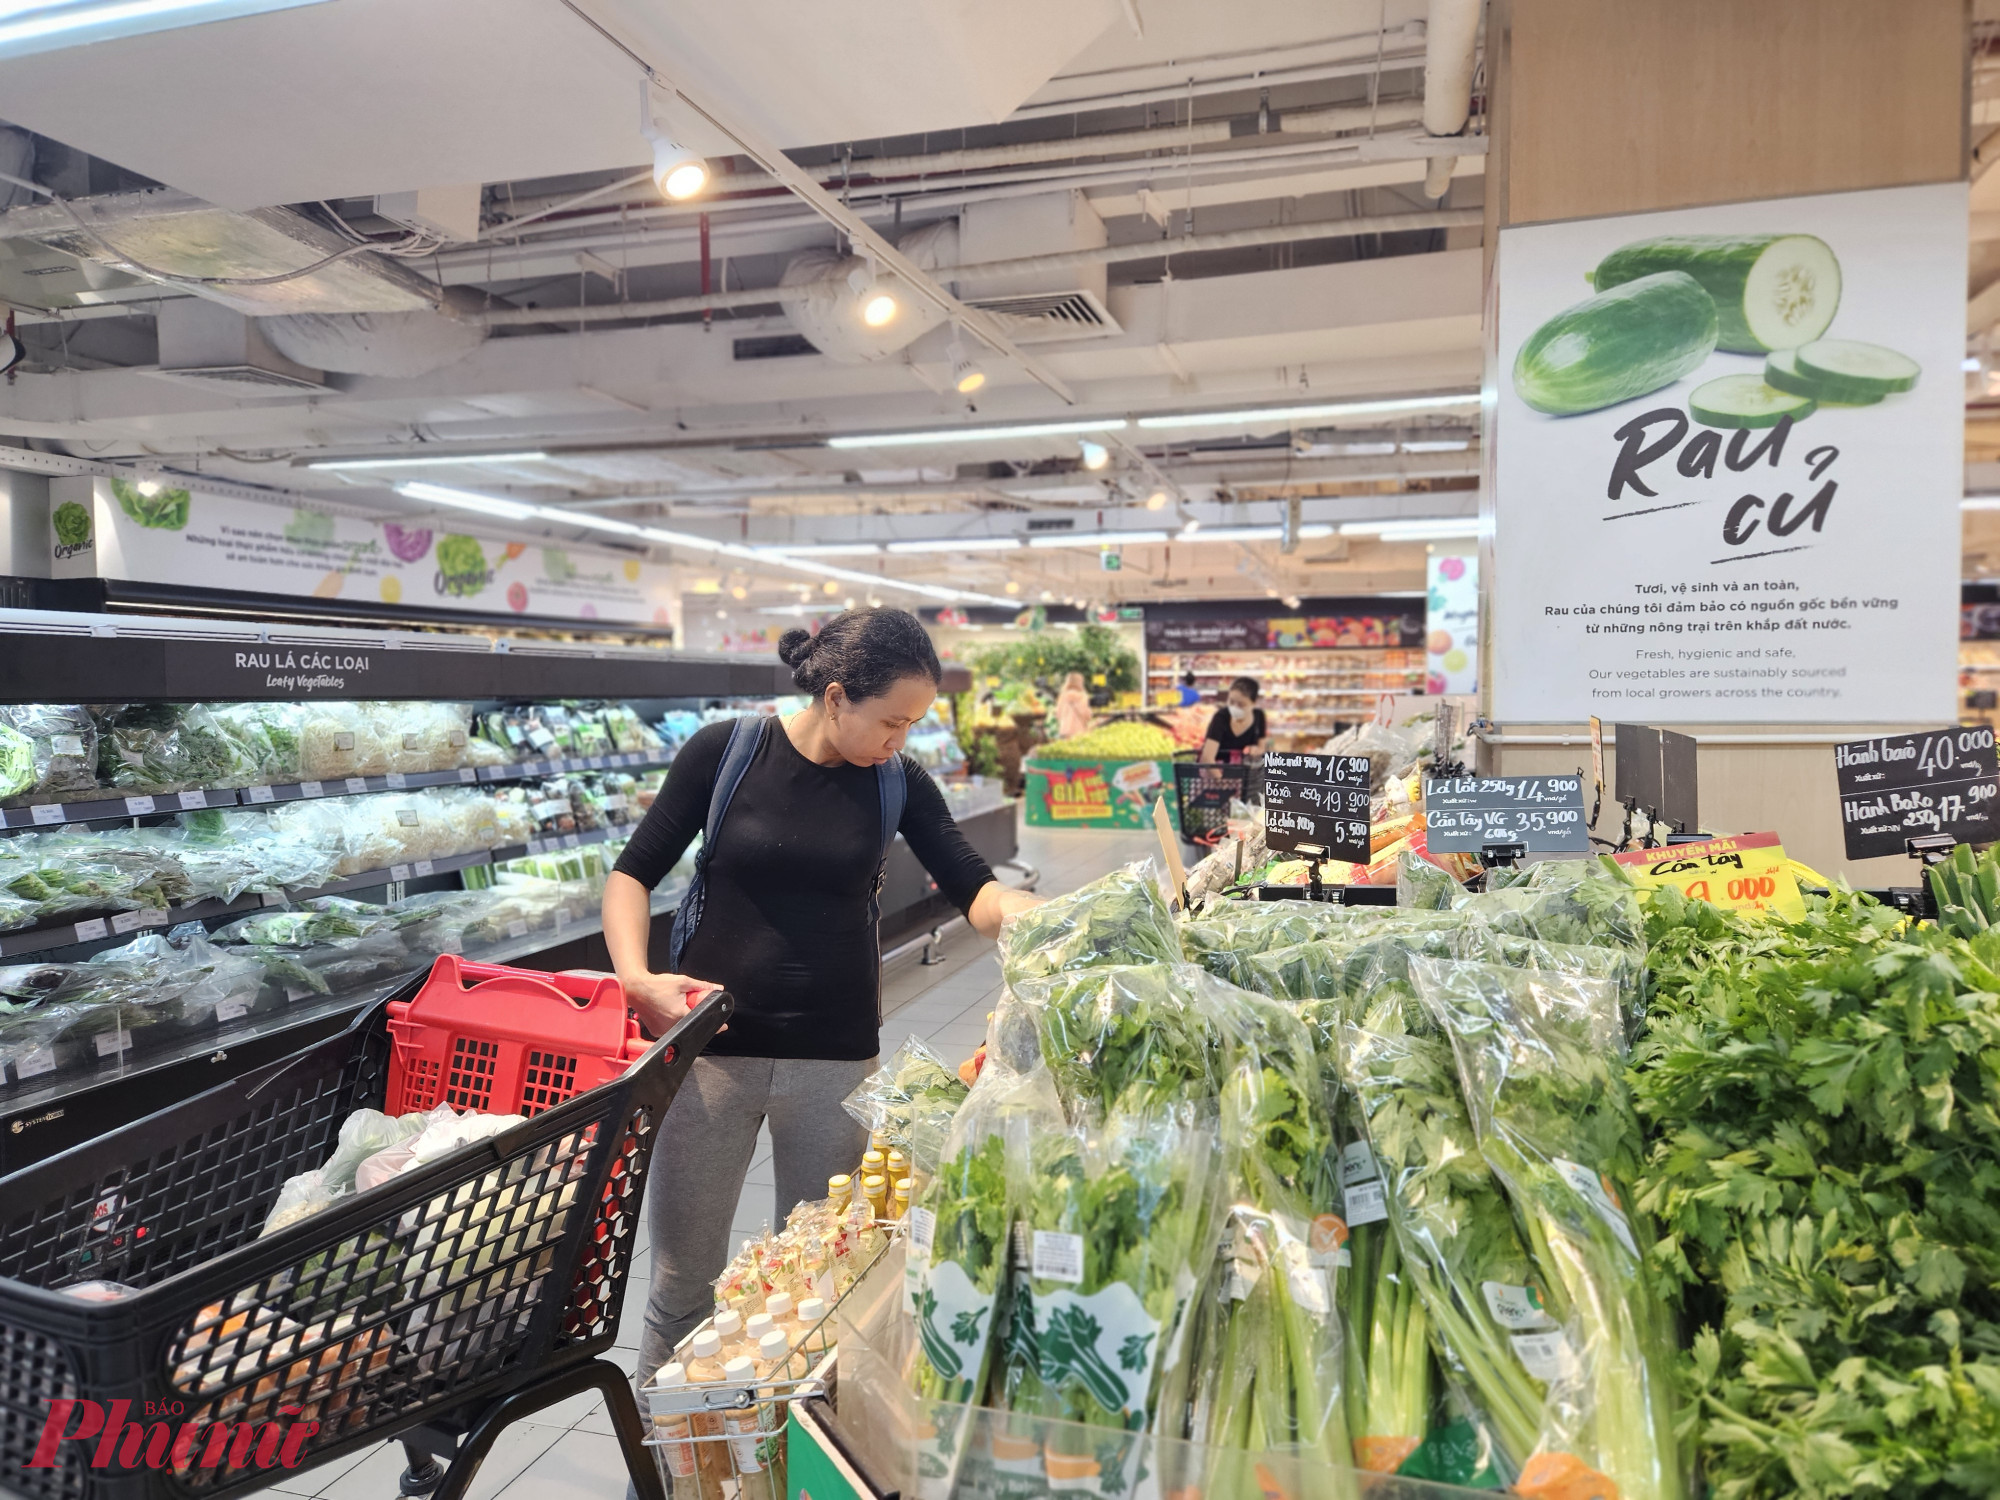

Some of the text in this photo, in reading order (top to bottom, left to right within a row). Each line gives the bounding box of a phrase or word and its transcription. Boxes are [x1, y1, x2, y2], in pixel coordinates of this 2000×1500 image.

[1607, 408, 1794, 500] Rau
[1722, 445, 1840, 546] củ
[55, 539, 93, 559] Organic
[1635, 580, 1799, 595] Tươi, vệ sinh và an toàn,
[1545, 607, 1569, 616] Rau
[1573, 604, 1596, 615] của
[1600, 603, 1640, 616] chúng
[1644, 602, 1662, 613] tôi
[1666, 601, 1695, 613] đảm
[1699, 600, 1725, 612] bảo
[1729, 600, 1747, 612] có
[1799, 597, 1826, 612] gốc
[1861, 597, 1899, 610] vững
[1586, 623, 1599, 634] từ
[1603, 622, 1645, 635] những
[1649, 622, 1683, 634] nông
[1687, 621, 1710, 634] trại
[1714, 620, 1742, 631] trên
[1746, 618, 1780, 632] khắp
[1784, 617, 1808, 630] đất
[235, 651, 369, 673] RAU LÁ CÁC LOẠI
[1636, 647, 1796, 661] Fresh, hygienic and safe,
[266, 674, 295, 691] Leafy
[1588, 666, 1847, 681] Our vegetables are sustainably sourced
[1592, 688, 1622, 698] from
[1625, 687, 1655, 698] local
[1658, 688, 1712, 700] growers
[1715, 688, 1758, 698] across
[1761, 687, 1783, 697] the
[1835, 740, 1879, 769] Hành
[1265, 782, 1280, 796] Bó
[1299, 787, 1322, 808] 250g
[1427, 779, 1451, 796] Lá
[1455, 777, 1478, 793] lốt
[1479, 779, 1515, 797] 250g
[1844, 796, 1890, 822] Hành
[1265, 811, 1277, 828] Lá
[1427, 811, 1457, 828] Cần
[1456, 811, 1483, 831] Tây
[1484, 812, 1509, 825] VG
[1902, 809, 1940, 832] 250g
[1645, 840, 1738, 862] KHUYẾN MÃI
[1650, 852, 1744, 876] Cần tây
